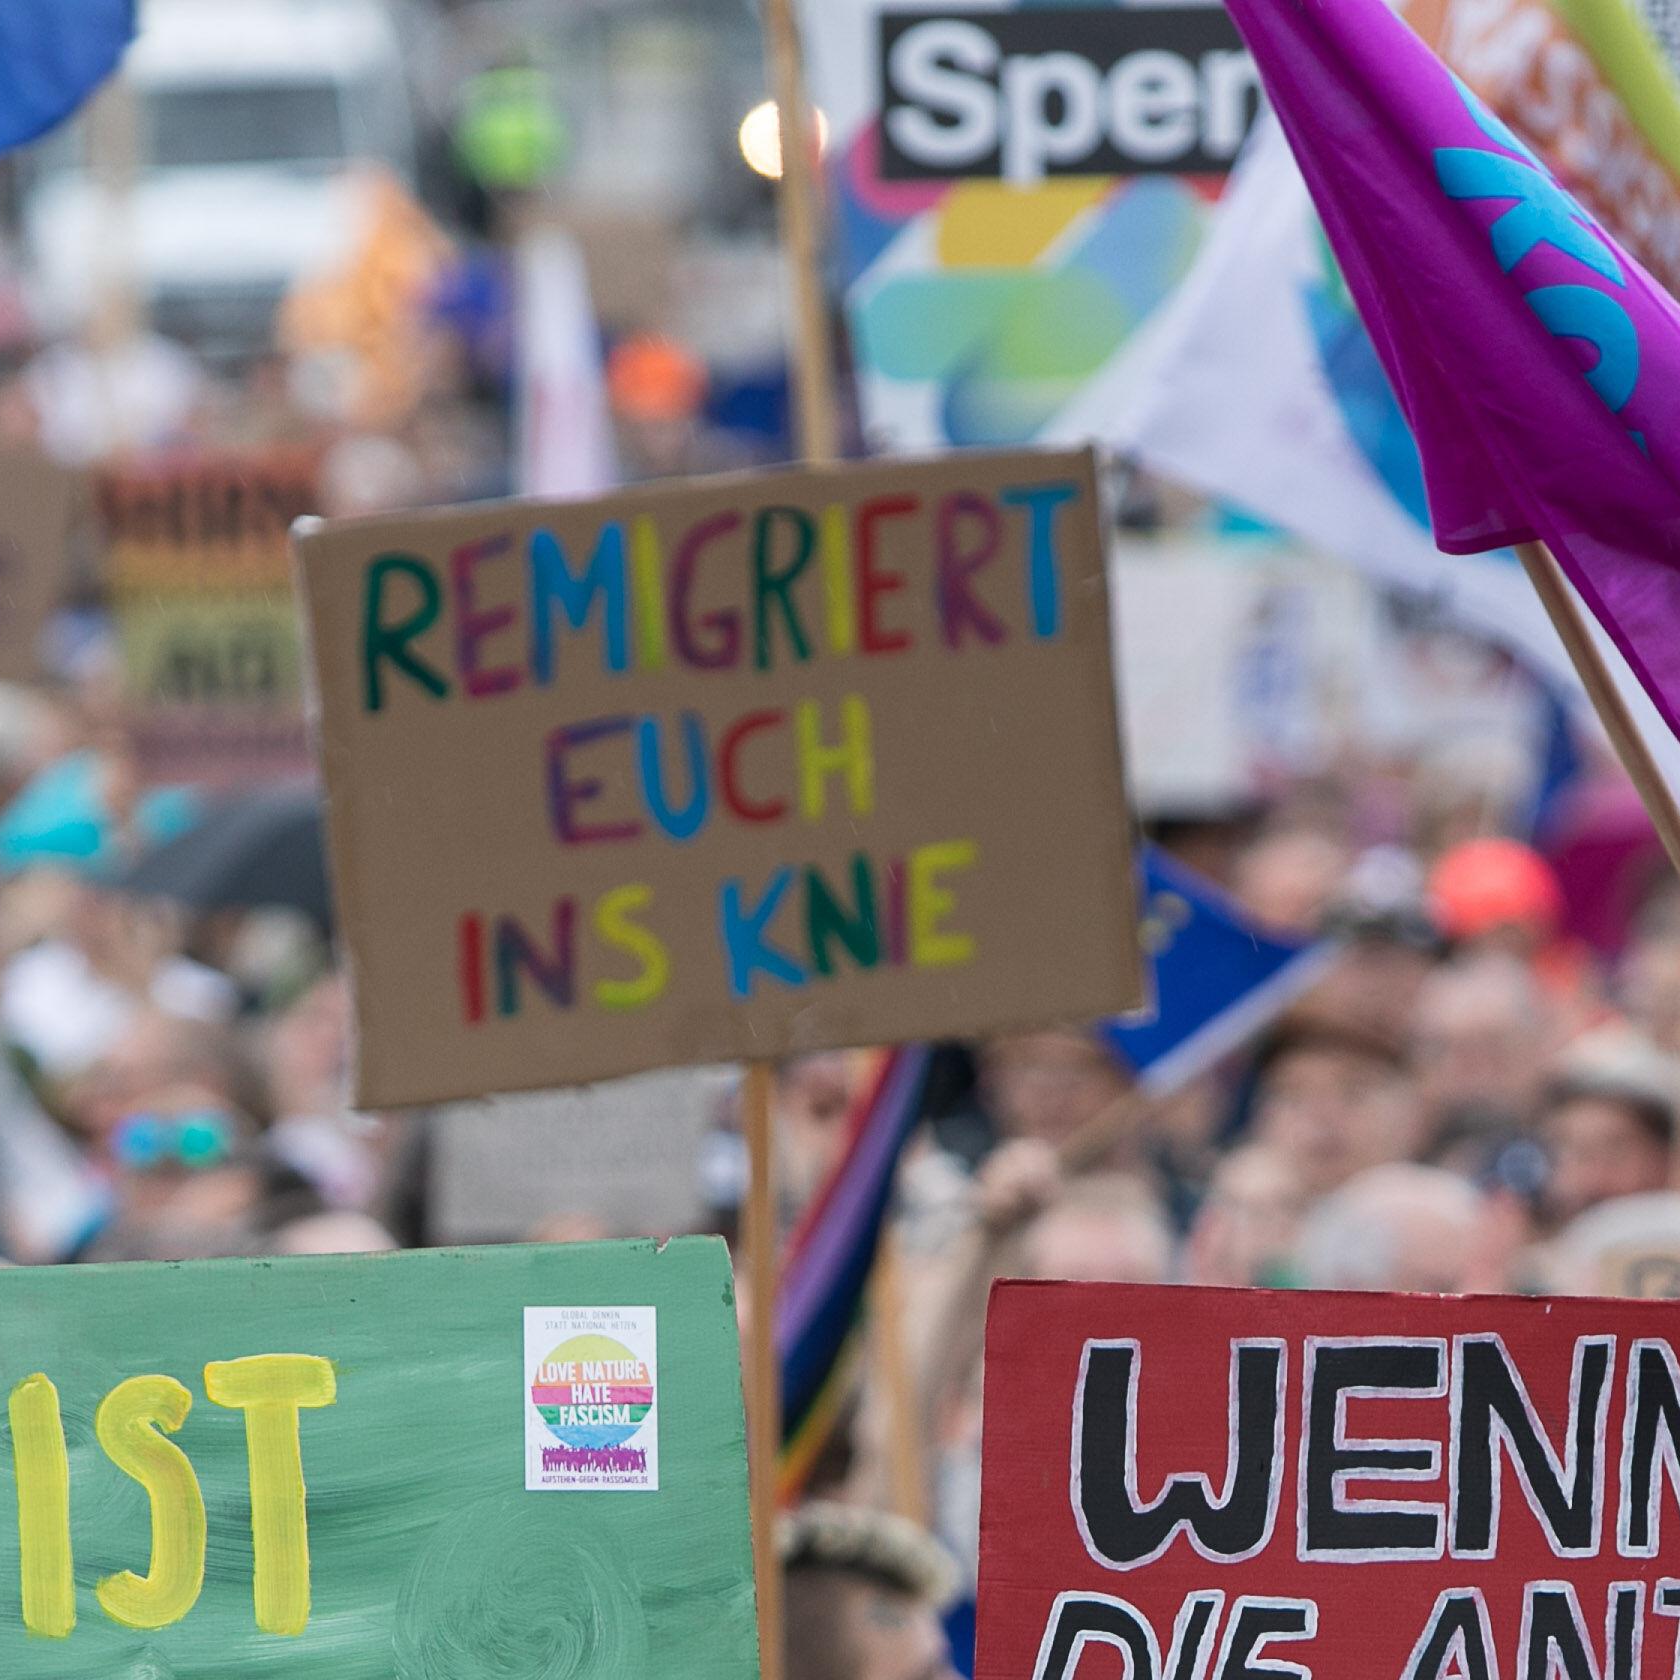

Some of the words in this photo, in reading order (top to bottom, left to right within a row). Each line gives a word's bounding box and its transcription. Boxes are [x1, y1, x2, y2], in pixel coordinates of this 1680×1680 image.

[363, 484, 1077, 713] REMIGRIERT
[546, 694, 875, 847] EUCH
[460, 884, 670, 1025] INS
[720, 840, 978, 1000] KNIE
[545, 1321, 568, 1330] STATT
[571, 1320, 606, 1330] NATIONAL
[561, 1310, 588, 1320] GLOBAL
[592, 1310, 620, 1319] DENKEN
[538, 1362, 577, 1383] LOVE
[582, 1360, 644, 1381] NATURE
[571, 1384, 612, 1404] HATE
[558, 1405, 631, 1426] FASCISM
[8, 1353, 337, 1638] IST
